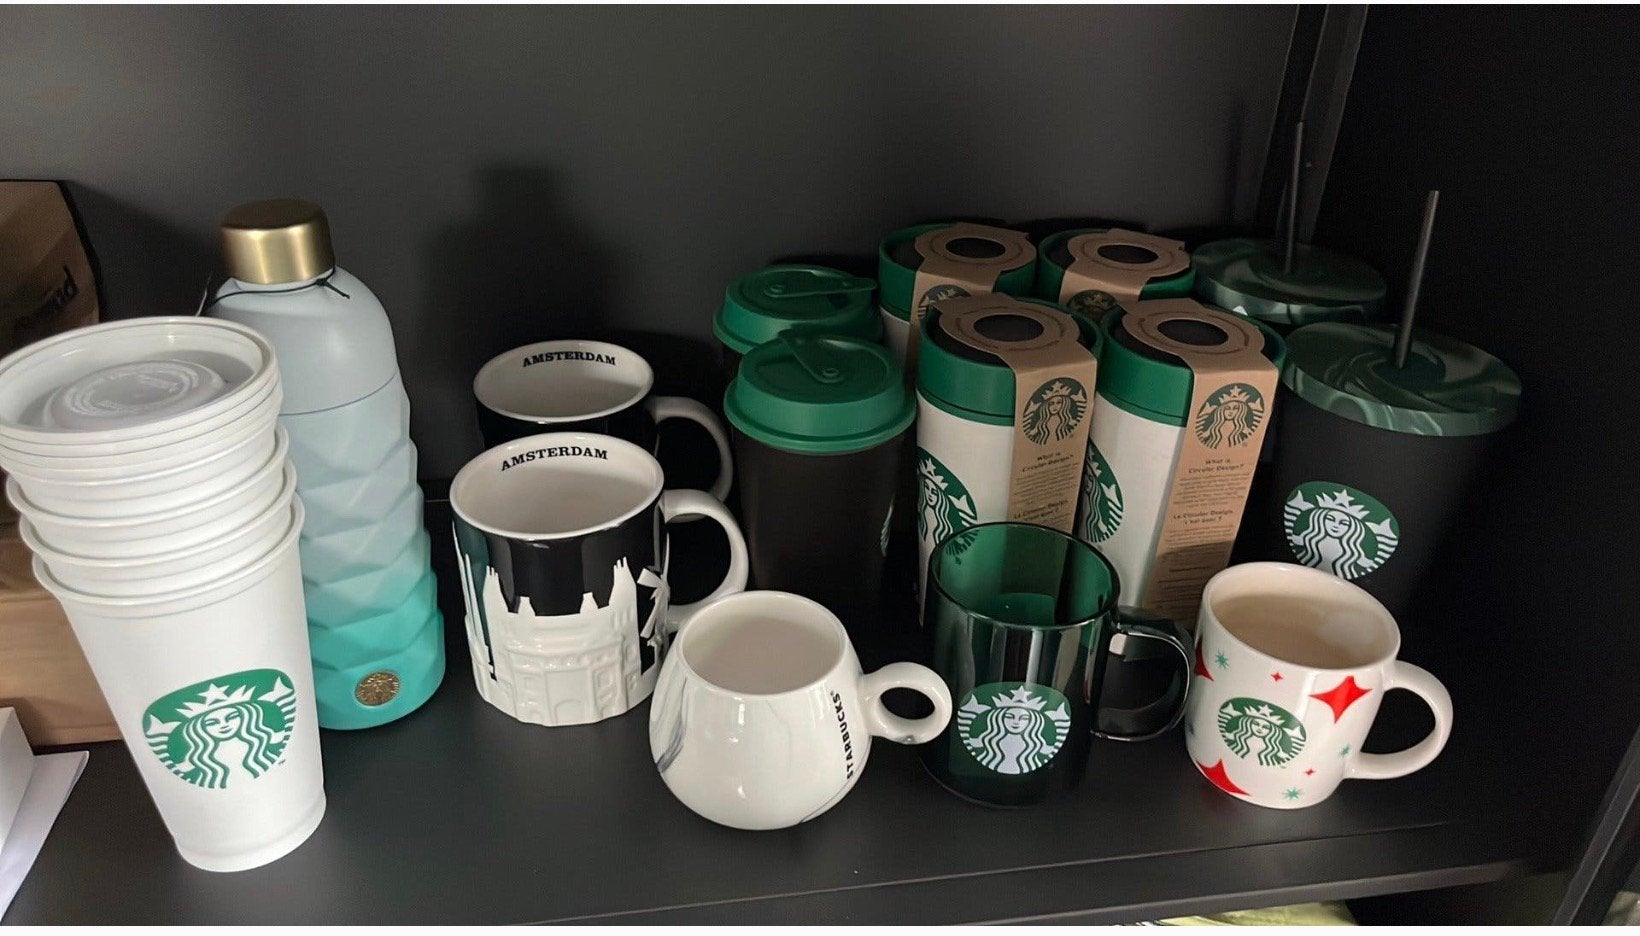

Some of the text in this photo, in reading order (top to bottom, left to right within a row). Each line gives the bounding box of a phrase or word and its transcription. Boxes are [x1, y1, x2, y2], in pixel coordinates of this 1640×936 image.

[523, 351, 616, 368] AMSTERDAM
[501, 446, 609, 471] AMSTERDAM
[1188, 466, 1215, 474] Circular
[832, 692, 854, 780] STARBUCKS
